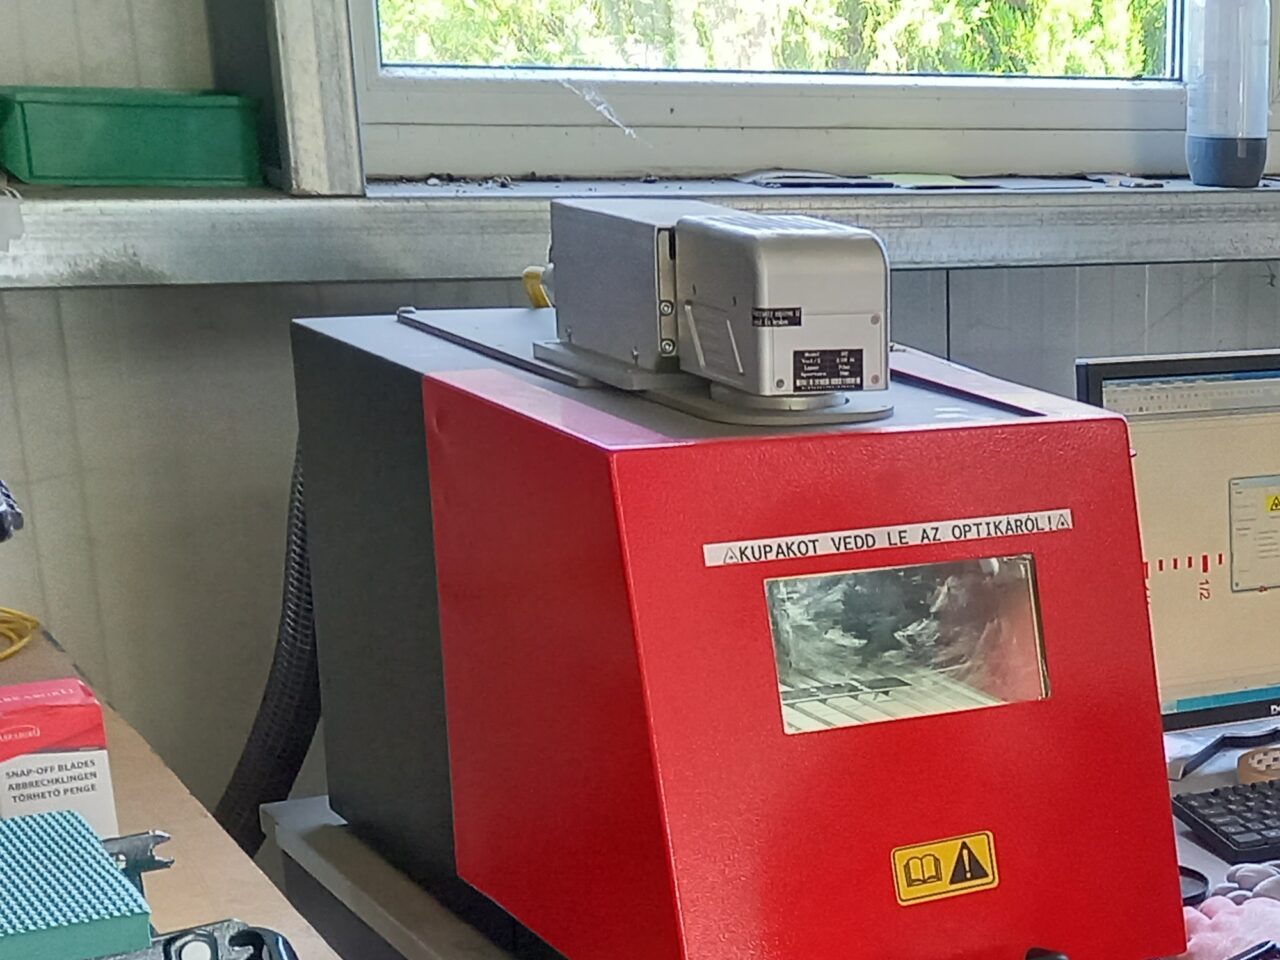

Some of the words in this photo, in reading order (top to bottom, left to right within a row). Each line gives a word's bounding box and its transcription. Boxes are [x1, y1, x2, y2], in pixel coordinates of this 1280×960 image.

[739, 539, 819, 562] KUPAKOT
[831, 533, 876, 552] VEDD
[887, 529, 909, 547] LE
[920, 526, 941, 543] AZ
[951, 514, 1053, 541] OPTIKÁRÓL!
[1199, 578, 1210, 600] 1/2
[63, 783, 97, 796] PENGE
